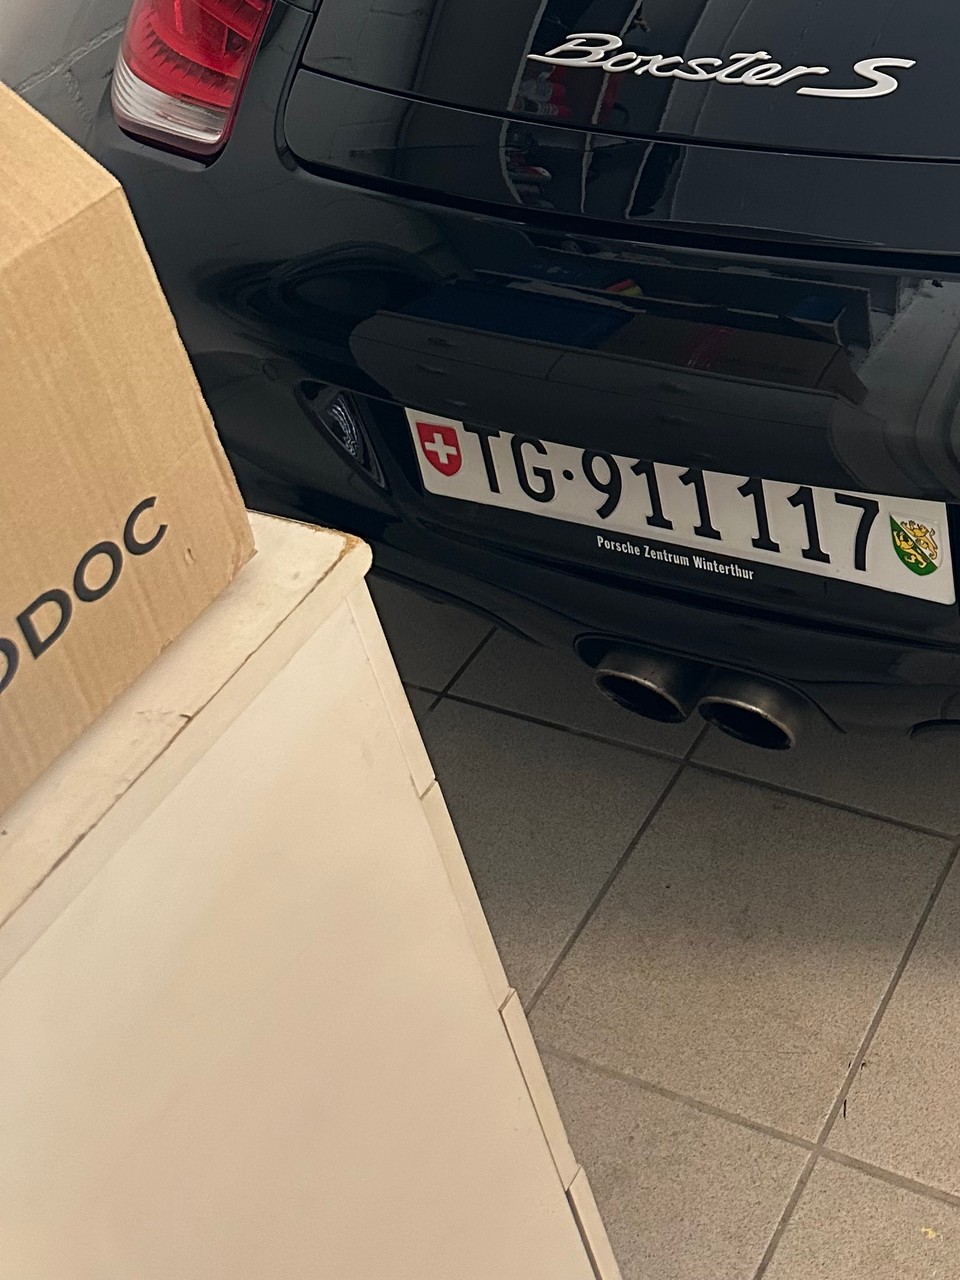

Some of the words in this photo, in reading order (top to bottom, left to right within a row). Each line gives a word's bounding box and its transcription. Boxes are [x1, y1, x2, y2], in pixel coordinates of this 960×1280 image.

[526, 32, 830, 87] Boxster
[796, 56, 917, 99] S
[596, 535, 641, 556] Porsche
[643, 545, 690, 567] Zentrum
[692, 555, 755, 581] Winterthur
